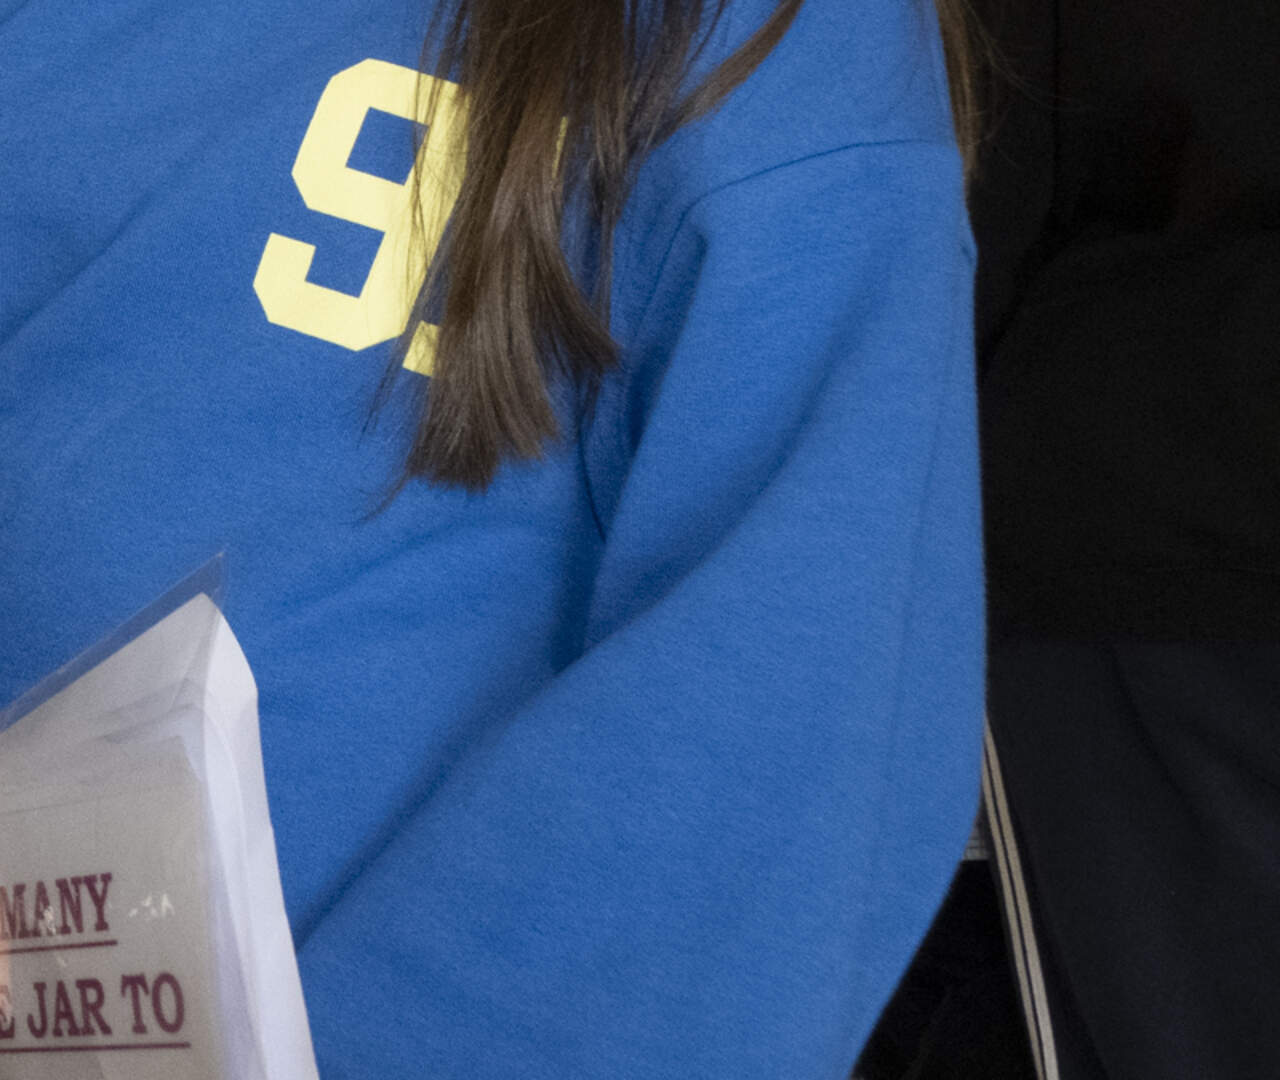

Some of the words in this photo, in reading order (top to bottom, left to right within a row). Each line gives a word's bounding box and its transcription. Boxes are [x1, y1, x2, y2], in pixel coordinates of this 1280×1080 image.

[253, 58, 472, 377] 9
[27, 978, 112, 1040] JAR
[122, 972, 185, 1036] TO
